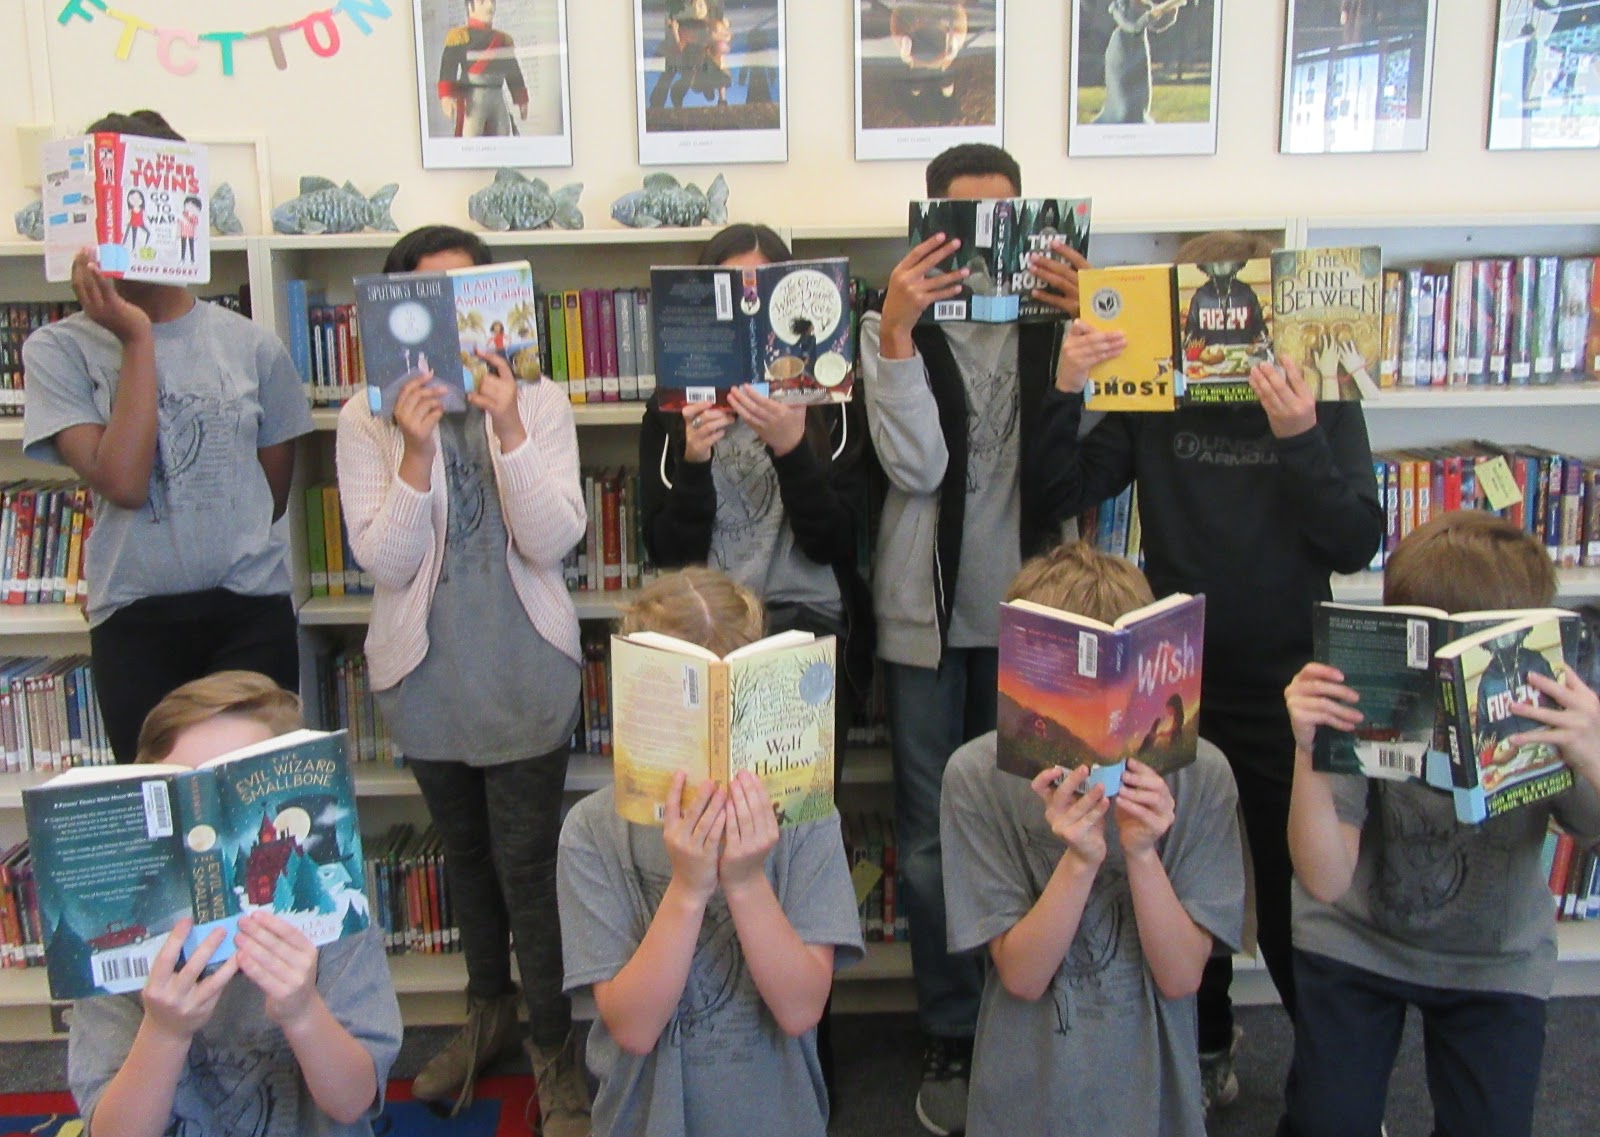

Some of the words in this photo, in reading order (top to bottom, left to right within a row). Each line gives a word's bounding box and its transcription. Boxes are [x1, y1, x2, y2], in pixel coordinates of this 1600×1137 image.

[157, 152, 175, 163] THE
[135, 157, 195, 179] TAPPER
[130, 168, 200, 195] TWINS
[150, 192, 169, 202] GO
[155, 203, 171, 214] TO
[147, 214, 175, 225] WAR
[130, 264, 159, 274] GEOFF
[1316, 255, 1338, 268] THE
[463, 280, 471, 294] It
[474, 276, 498, 292] Ain't
[1011, 272, 1049, 292] ROB
[1275, 279, 1377, 315] BETWEEN
[1019, 306, 1038, 316] ETER
[1199, 306, 1249, 331] FUZZY
[766, 734, 801, 756] Wolf
[754, 755, 812, 775] Hollow
[235, 769, 270, 794] EVIL
[273, 758, 337, 777] WIZARD
[241, 773, 334, 805] SMALLBONE
[212, 892, 226, 920] WIZ
